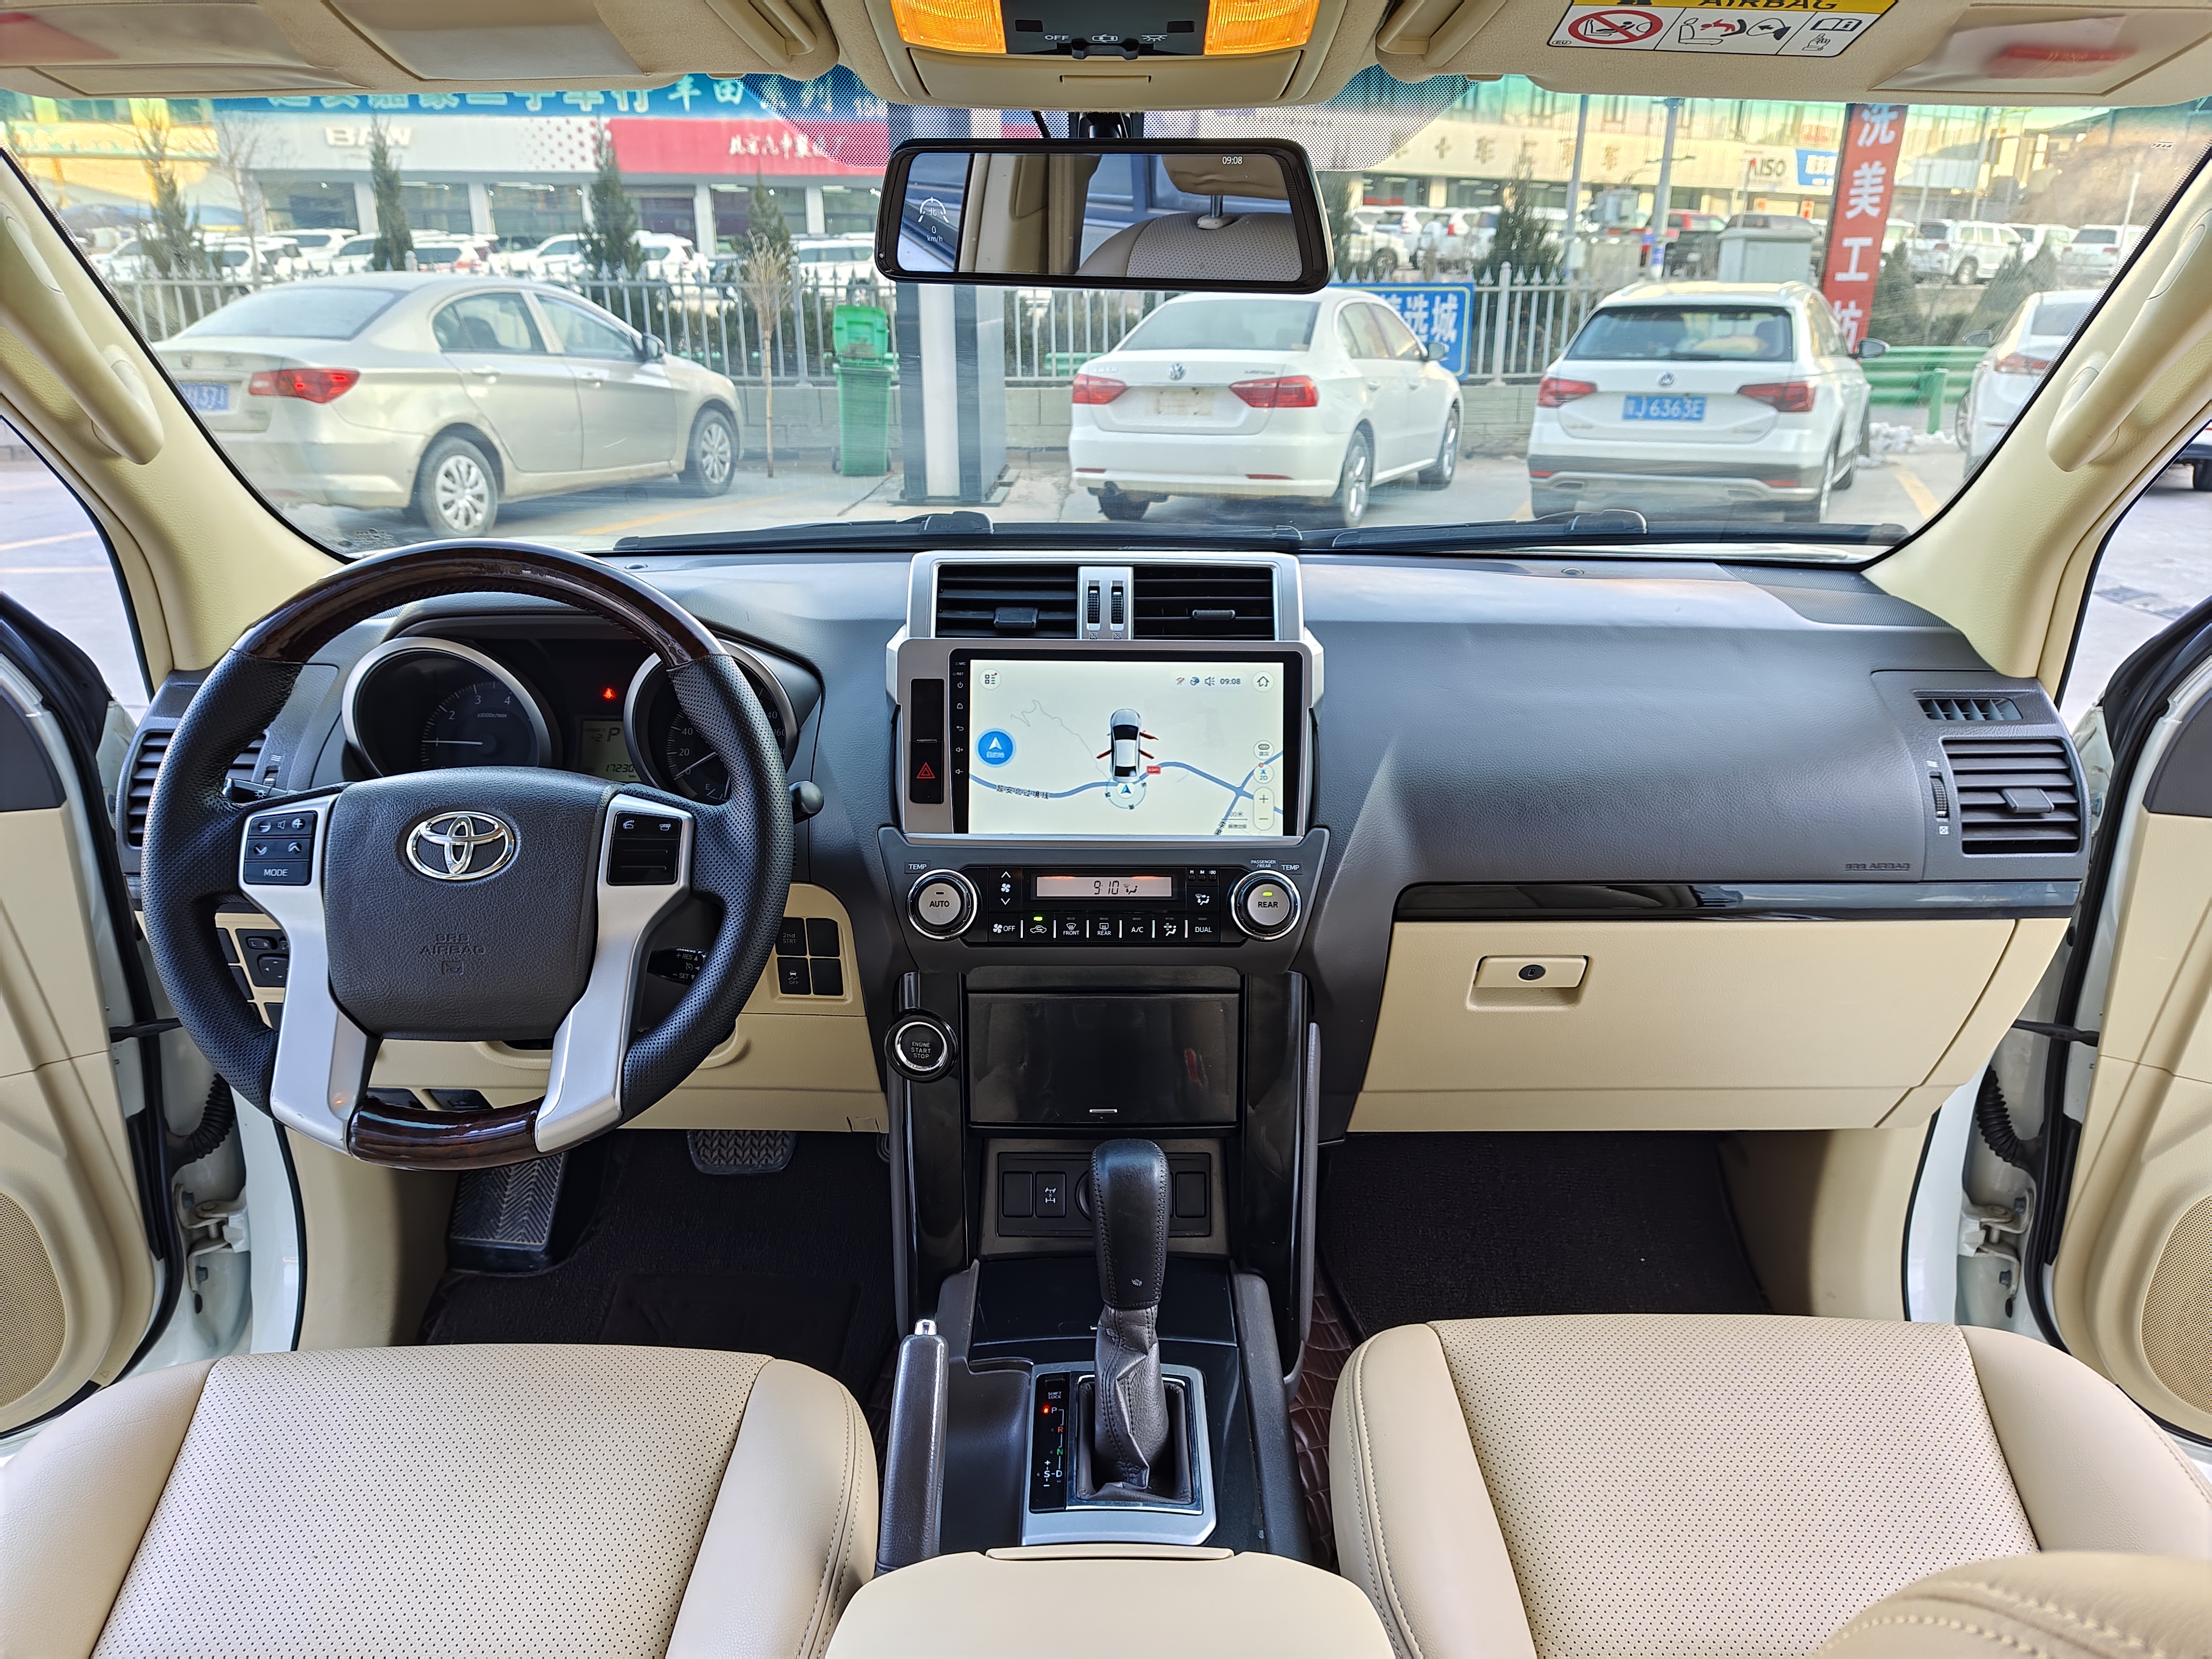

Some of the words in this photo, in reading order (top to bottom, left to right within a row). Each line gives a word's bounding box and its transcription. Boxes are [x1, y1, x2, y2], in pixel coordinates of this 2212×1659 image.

[1222, 156, 1243, 164] 09:08
[475, 695, 481, 705] 3
[504, 695, 511, 705] 4
[449, 710, 455, 720] 2
[606, 727, 621, 742] P
[682, 727, 693, 736] 40
[679, 748, 690, 756] 20
[264, 868, 288, 876] MODE
[1094, 880, 1120, 895] 9:10
[1043, 1470, 1050, 1478] S
